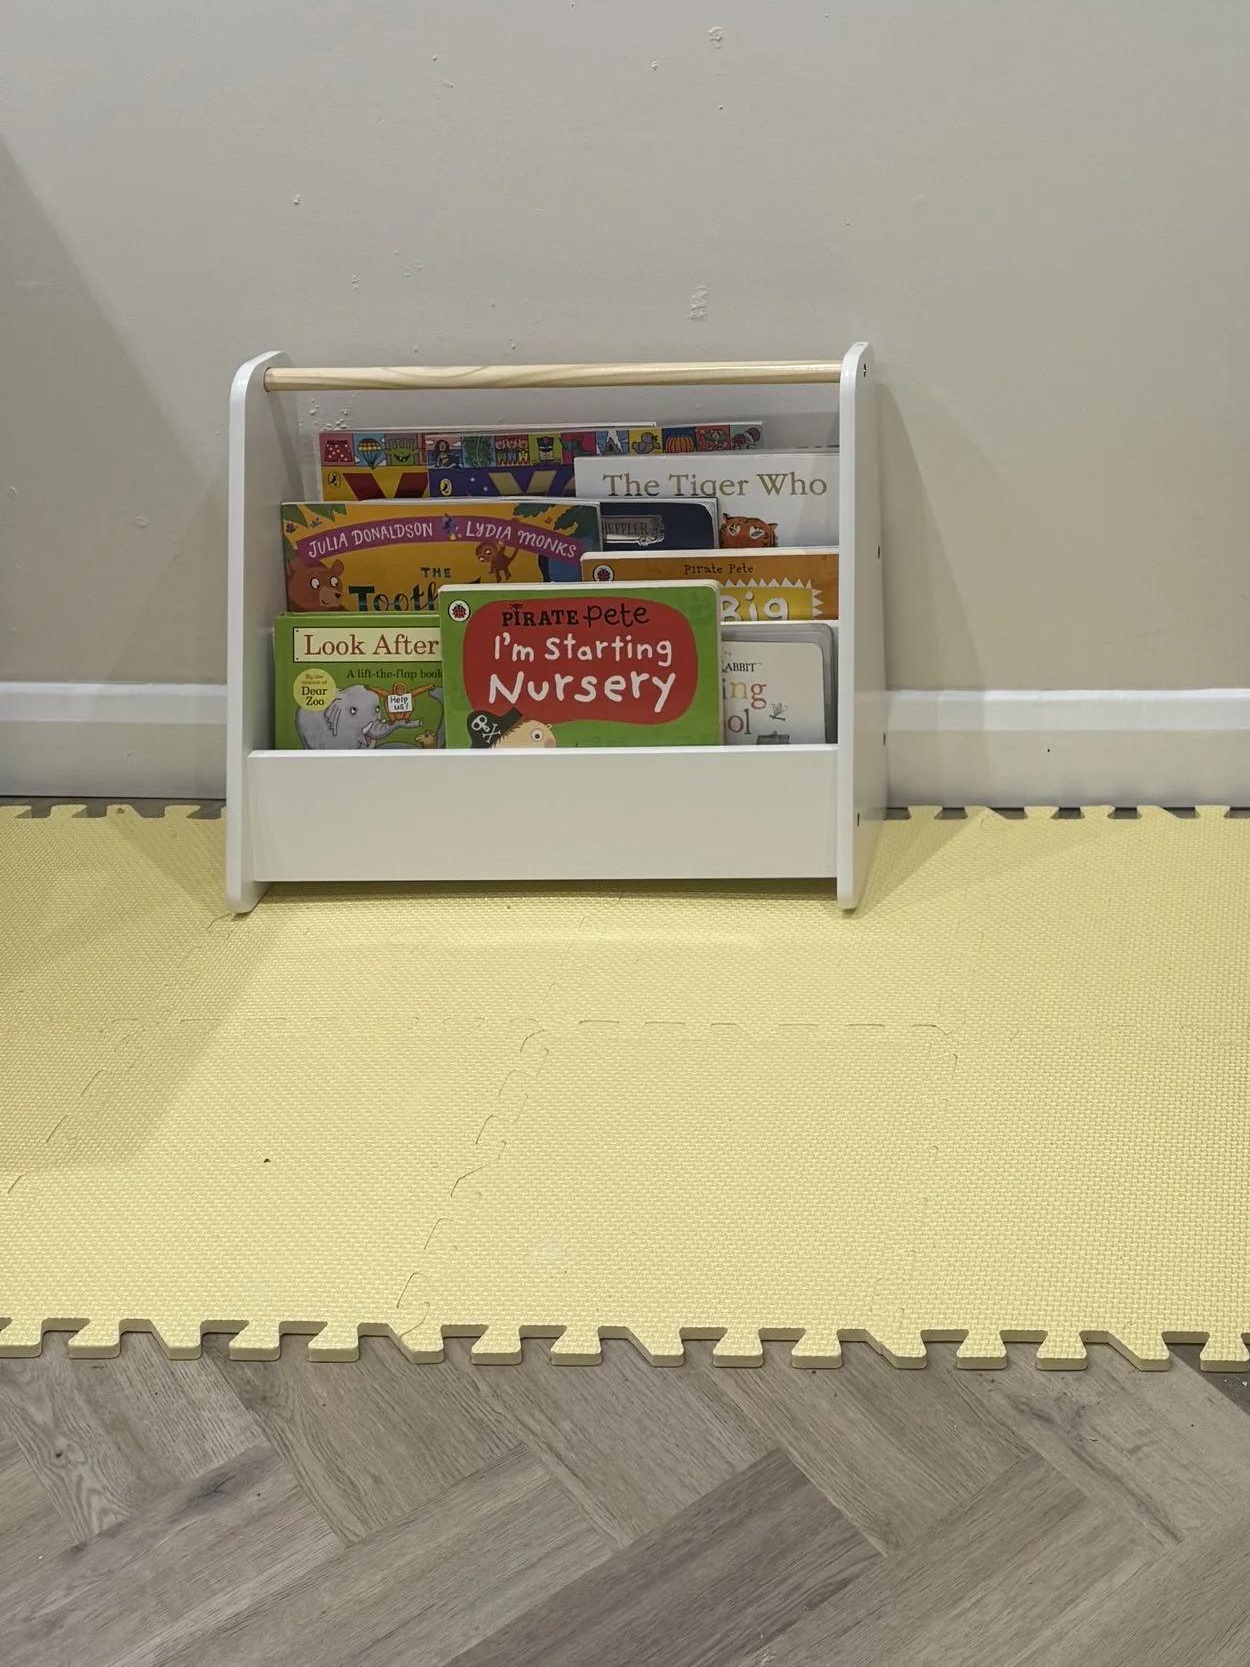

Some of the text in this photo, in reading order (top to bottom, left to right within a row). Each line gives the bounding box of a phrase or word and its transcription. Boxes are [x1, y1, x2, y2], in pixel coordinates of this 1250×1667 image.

[602, 473, 660, 497] The
[756, 471, 828, 496] Who
[308, 534, 349, 558] JULIA
[351, 522, 433, 546] DONALDSON
[466, 520, 511, 540] LYDIA
[420, 567, 451, 578] THE
[728, 563, 754, 574] Pete
[303, 633, 440, 655] Look After
[494, 632, 672, 667] I'm Starting
[722, 662, 756, 673] ABBIT
[346, 669, 355, 679] A
[301, 686, 328, 696] Dear
[488, 670, 676, 713] Nursery
[306, 696, 325, 706] Zoo
[390, 696, 409, 705] Help
